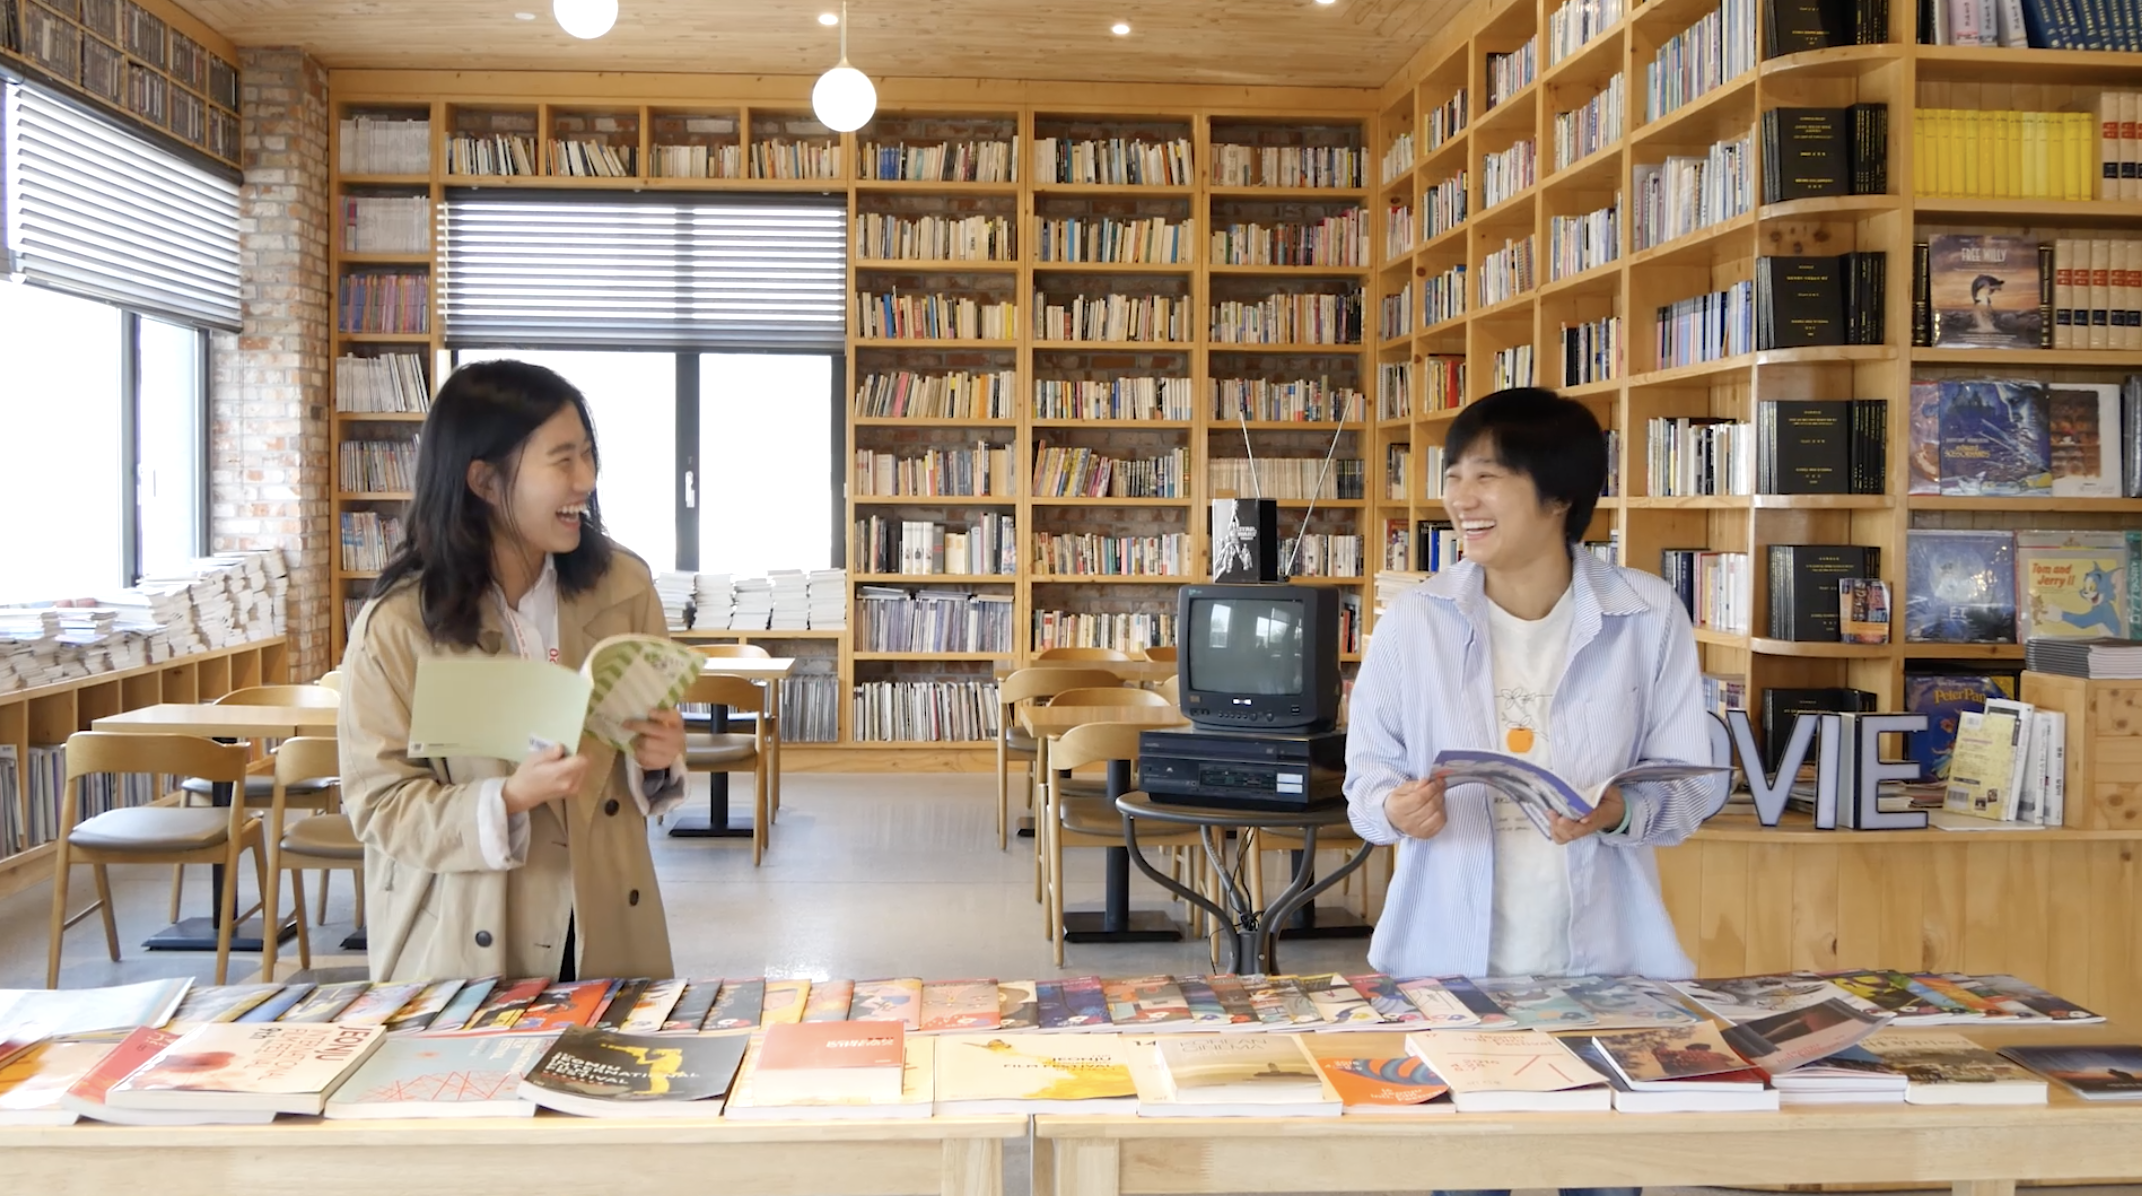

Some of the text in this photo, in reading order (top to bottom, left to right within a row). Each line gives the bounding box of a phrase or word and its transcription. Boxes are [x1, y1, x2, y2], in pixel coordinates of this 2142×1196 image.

[1961, 248, 2007, 262] FREE WILLY
[2032, 562, 2072, 574] Tom and
[2037, 574, 2065, 588] Jerry
[1934, 688, 1986, 705] Peter Pan
[314, 1025, 374, 1062] JEONJU
